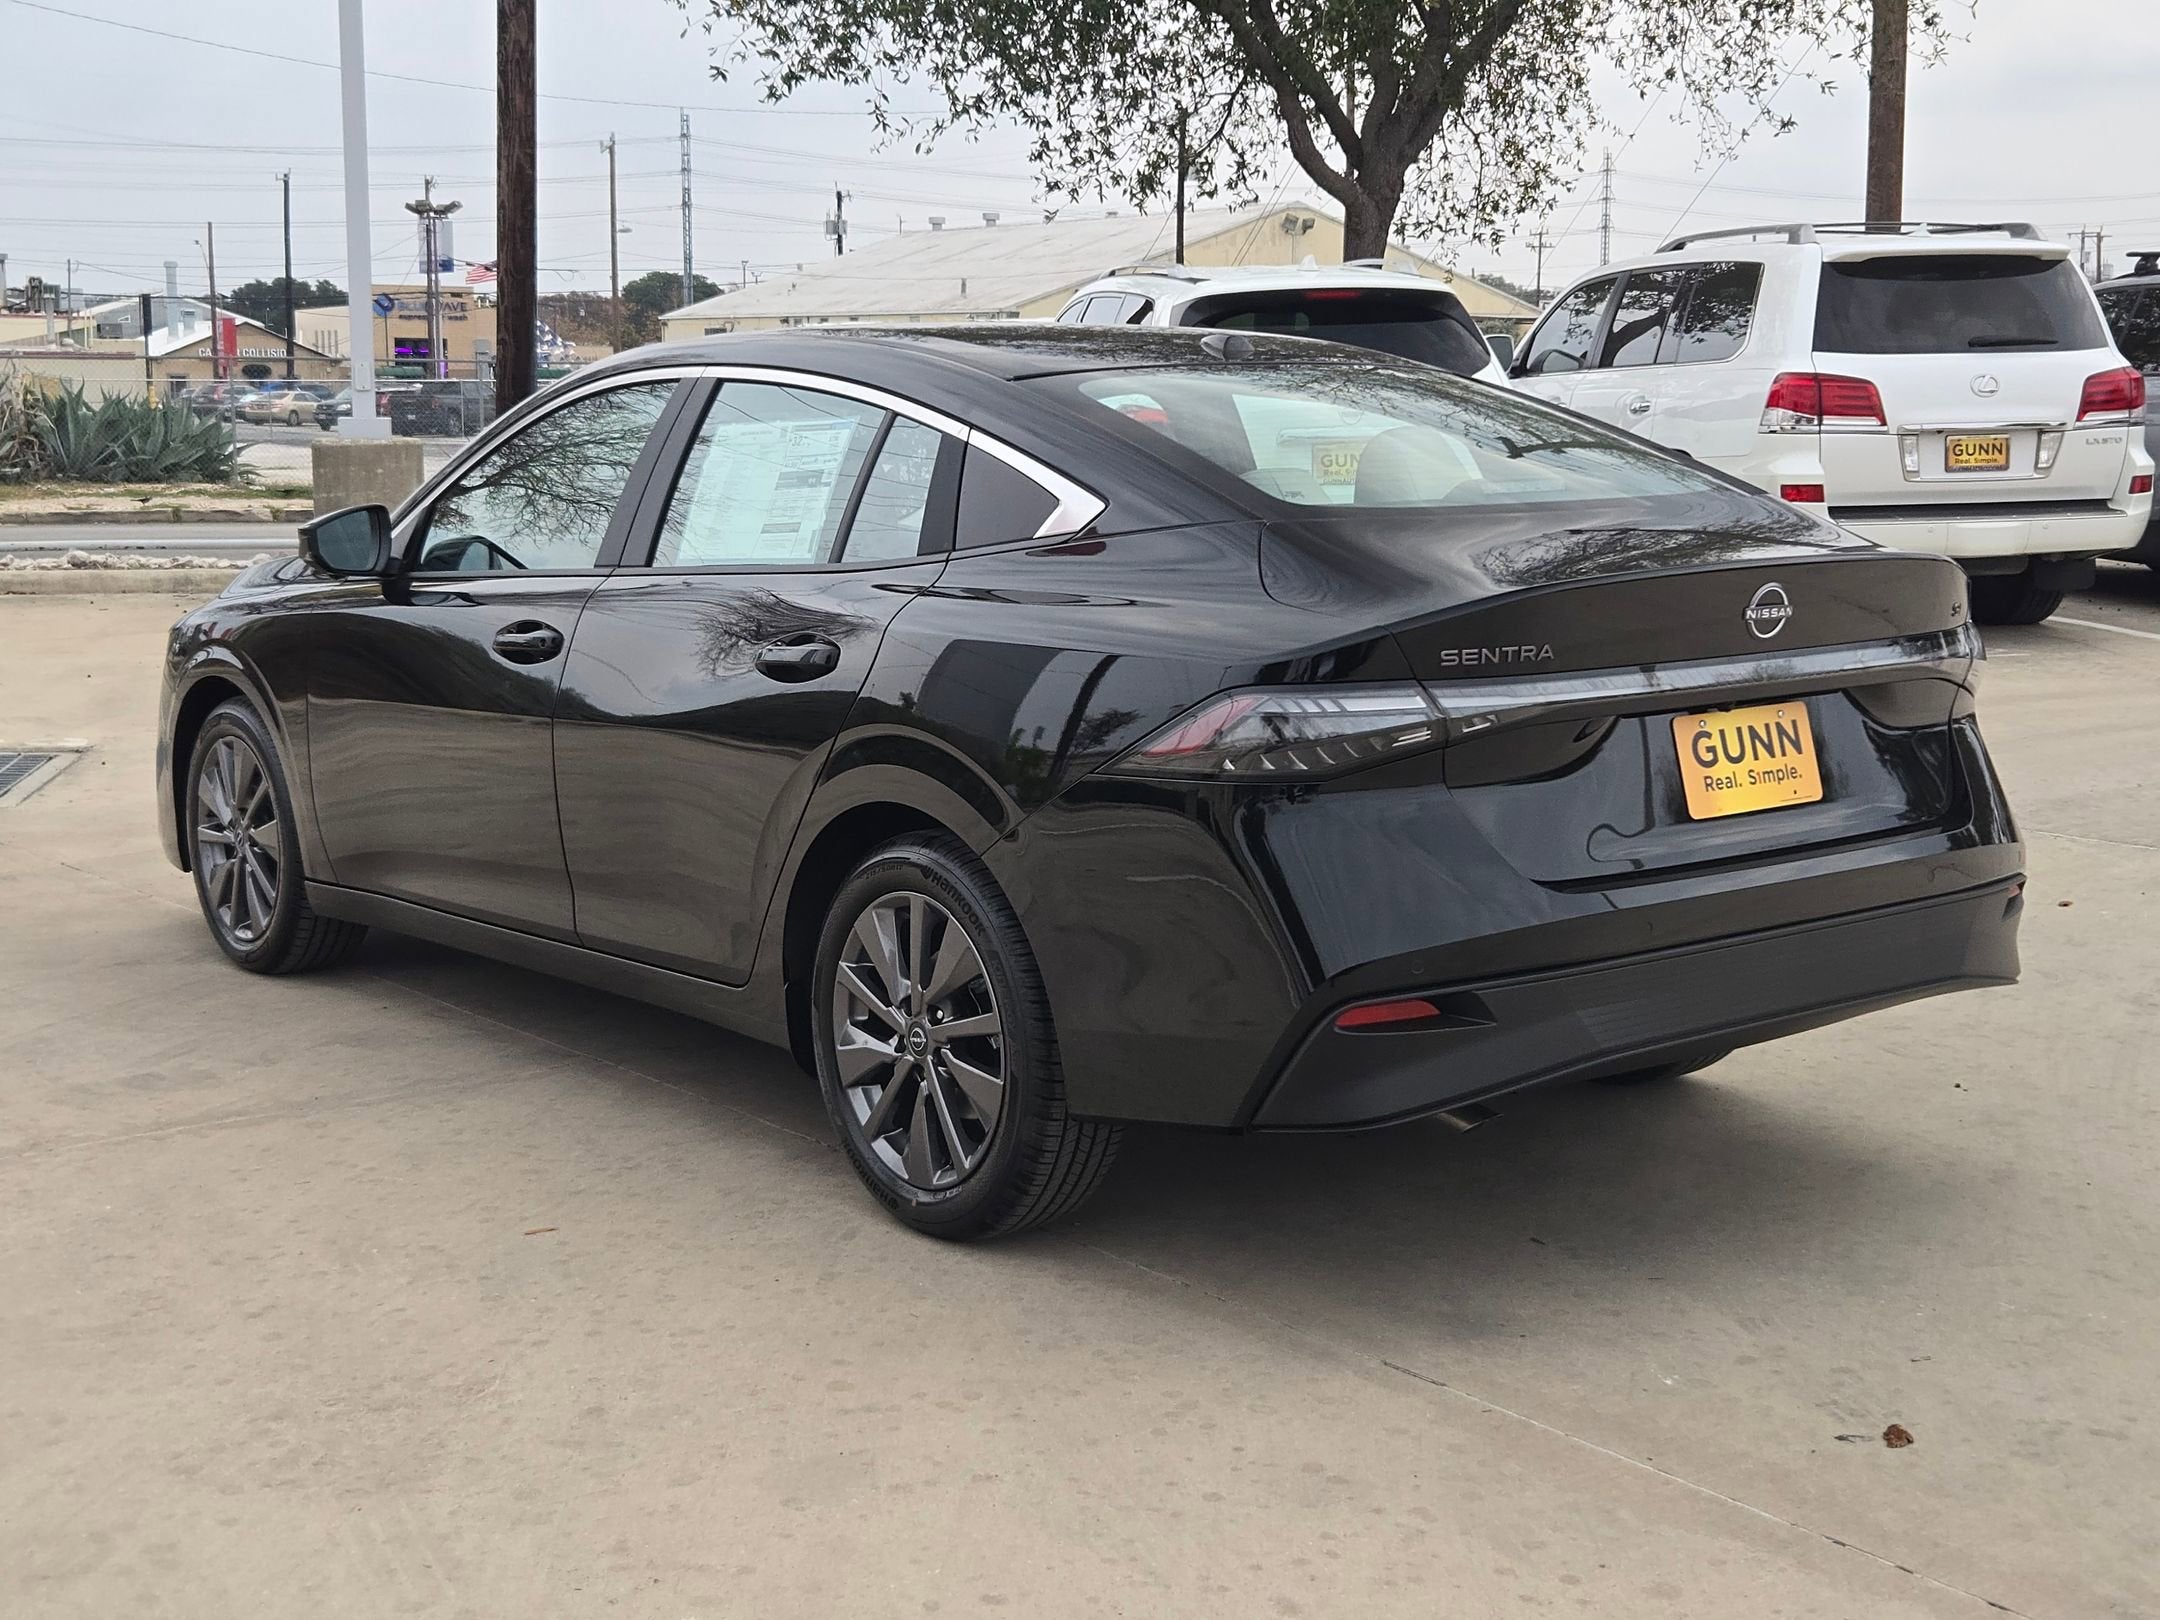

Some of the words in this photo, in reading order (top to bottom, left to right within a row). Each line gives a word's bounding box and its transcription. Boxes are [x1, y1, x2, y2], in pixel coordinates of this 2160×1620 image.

[243, 348, 287, 357] COLLISIO
[1952, 442, 2003, 457] GUNN
[1320, 454, 1360, 467] GUN
[1745, 606, 1792, 619] NISSAN
[1440, 644, 1554, 666] SENTRA
[1691, 719, 1803, 769] GUNN
[1703, 771, 1743, 792] Real.
